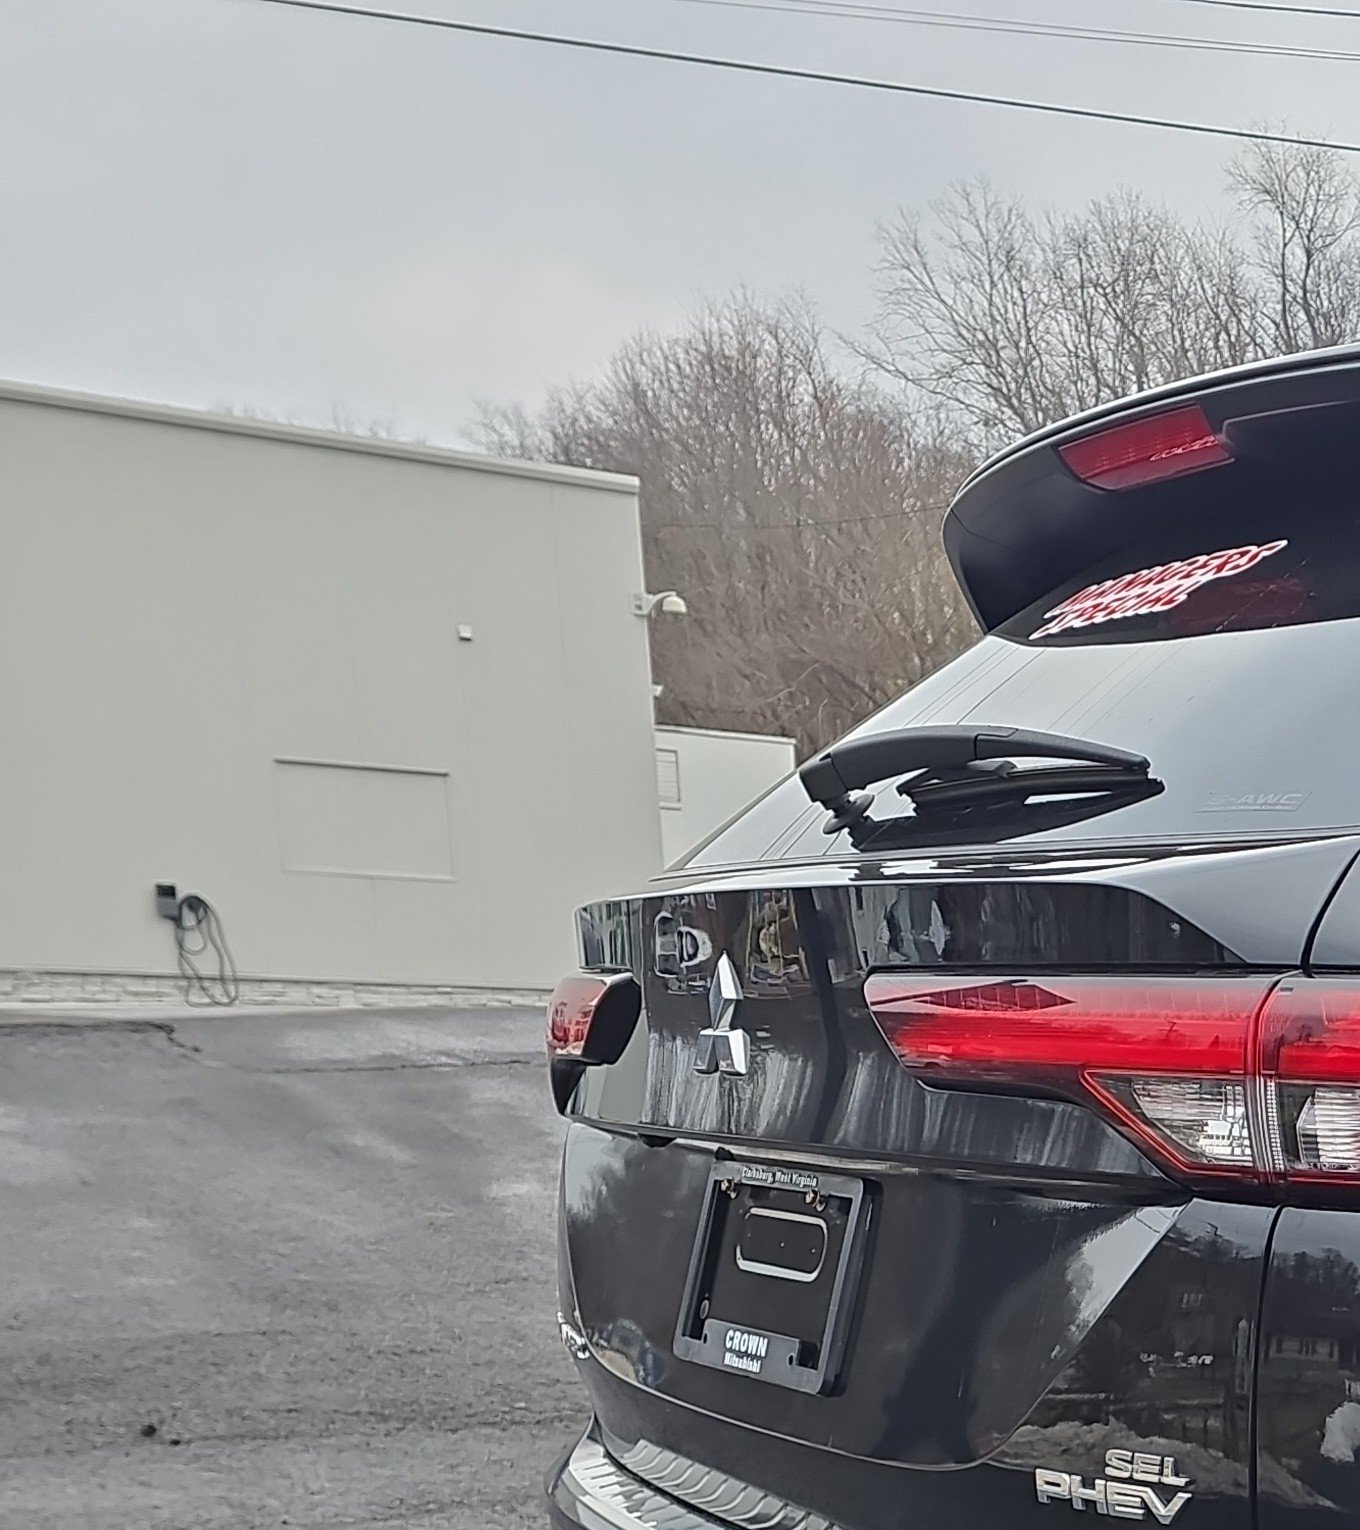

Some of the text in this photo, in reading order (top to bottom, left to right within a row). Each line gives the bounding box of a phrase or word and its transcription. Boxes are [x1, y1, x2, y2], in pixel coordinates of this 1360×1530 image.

[1042, 538, 1289, 618] MANAGERS
[1028, 583, 1193, 640] SPECIAL
[725, 1329, 768, 1357] CROWN
[1035, 1468, 1193, 1525] PHEV
[1104, 1449, 1191, 1487] SEL
